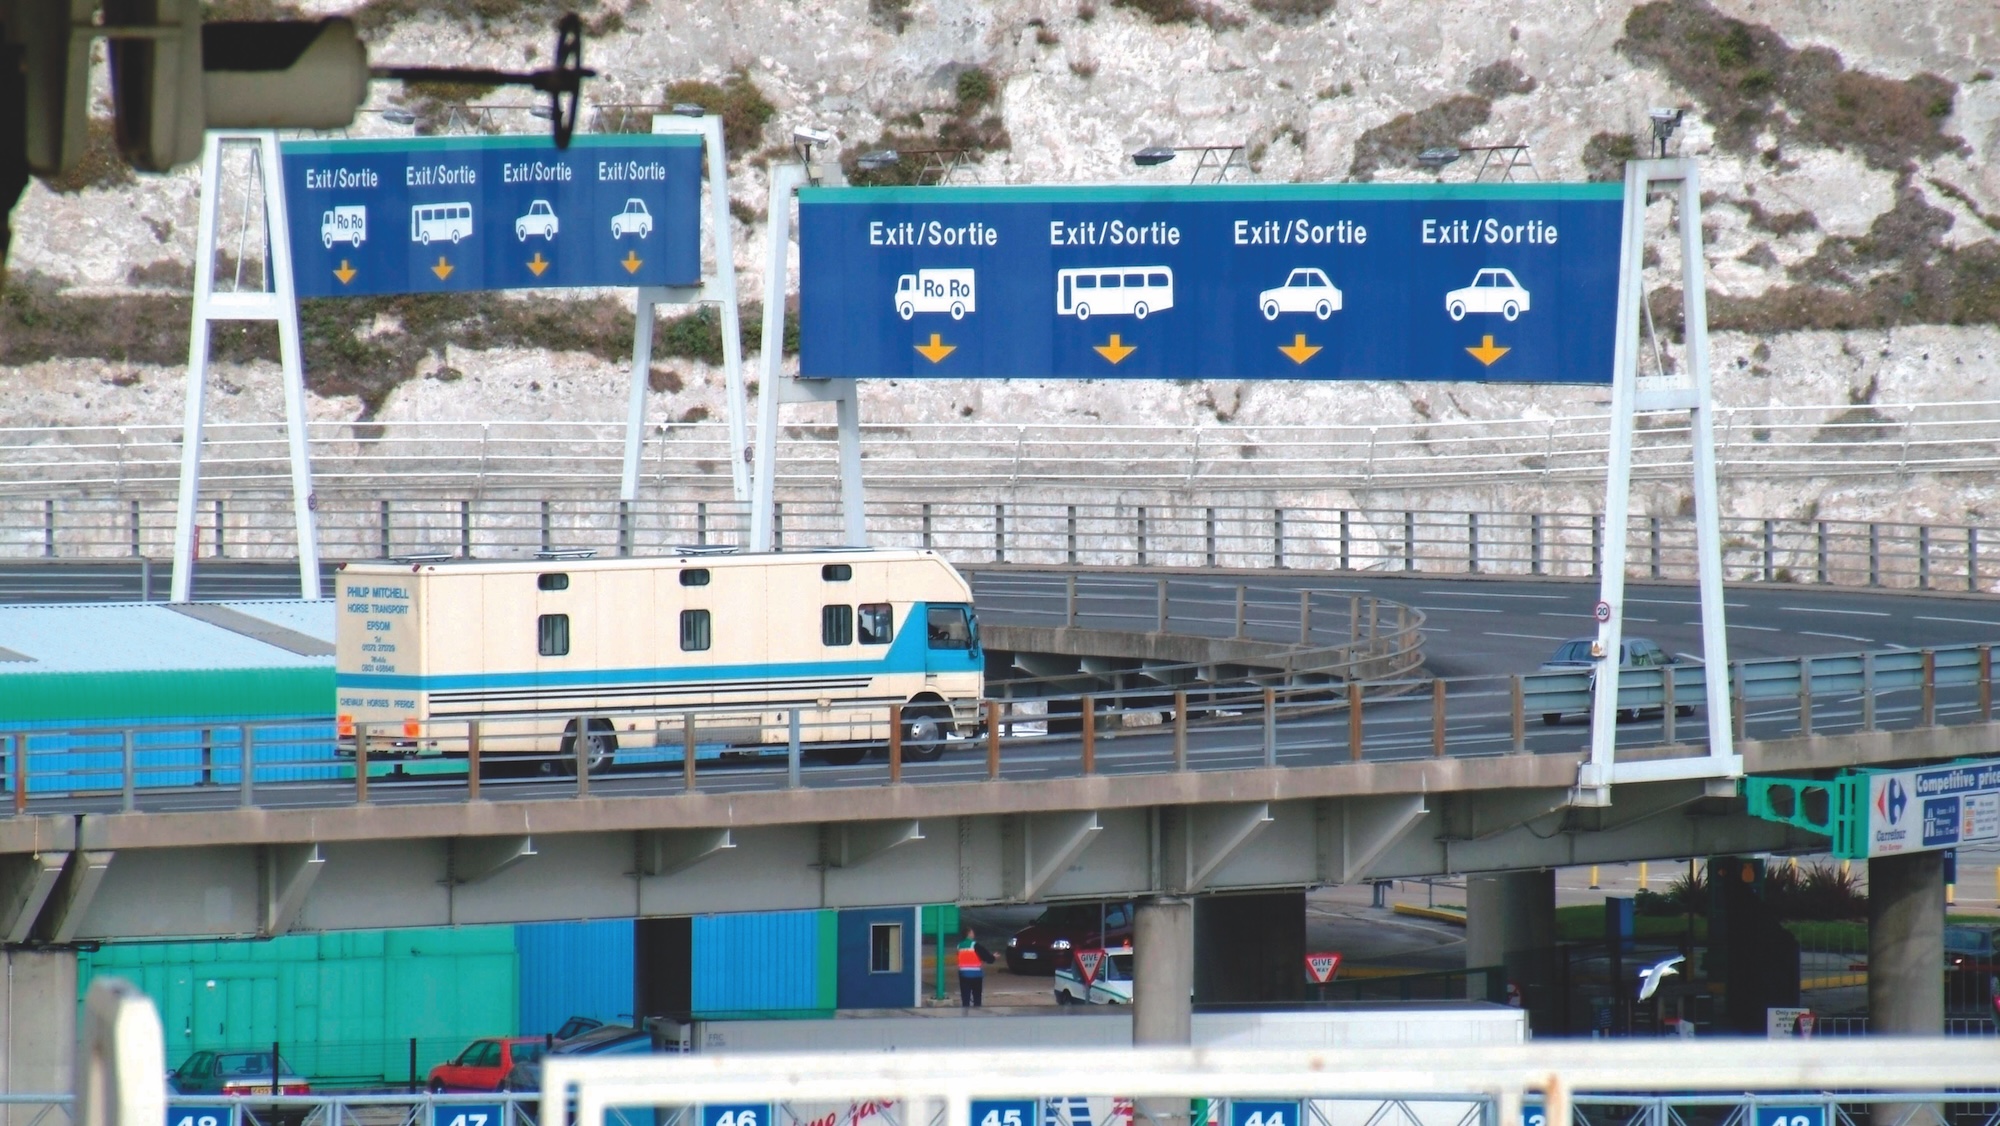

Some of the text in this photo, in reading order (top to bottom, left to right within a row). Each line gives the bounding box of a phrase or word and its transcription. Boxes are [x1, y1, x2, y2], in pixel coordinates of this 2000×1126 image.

[306, 168, 378, 189] Exit/Sortie
[406, 165, 476, 186] Exit/Sortie
[503, 161, 572, 183] Exit/Sortie
[598, 160, 666, 181] Exit/Sortie
[336, 214, 363, 229] Ro Ro
[870, 221, 998, 246] Exit/Sortie
[1050, 221, 1181, 246] Exit/Sortie
[1234, 219, 1367, 245] Exit/Sortie
[1422, 218, 1558, 245] Exit/Sortie
[924, 279, 970, 298] Ro Ro
[347, 586, 409, 599] PHILIP MITCHELL
[347, 604, 408, 614] HORSE TRANSPORT
[1597, 607, 1608, 616] 20
[367, 621, 391, 631] EPSOM
[340, 698, 415, 708] CHEVAUX HORSES PFERDE
[1917, 769, 1975, 794] Competitive
[1876, 829, 1906, 841] Carrefour
[708, 1033, 724, 1041] FRC
[715, 1110, 757, 1126] 46
[981, 1109, 1022, 1126] 45
[1244, 1111, 1284, 1126] 44
